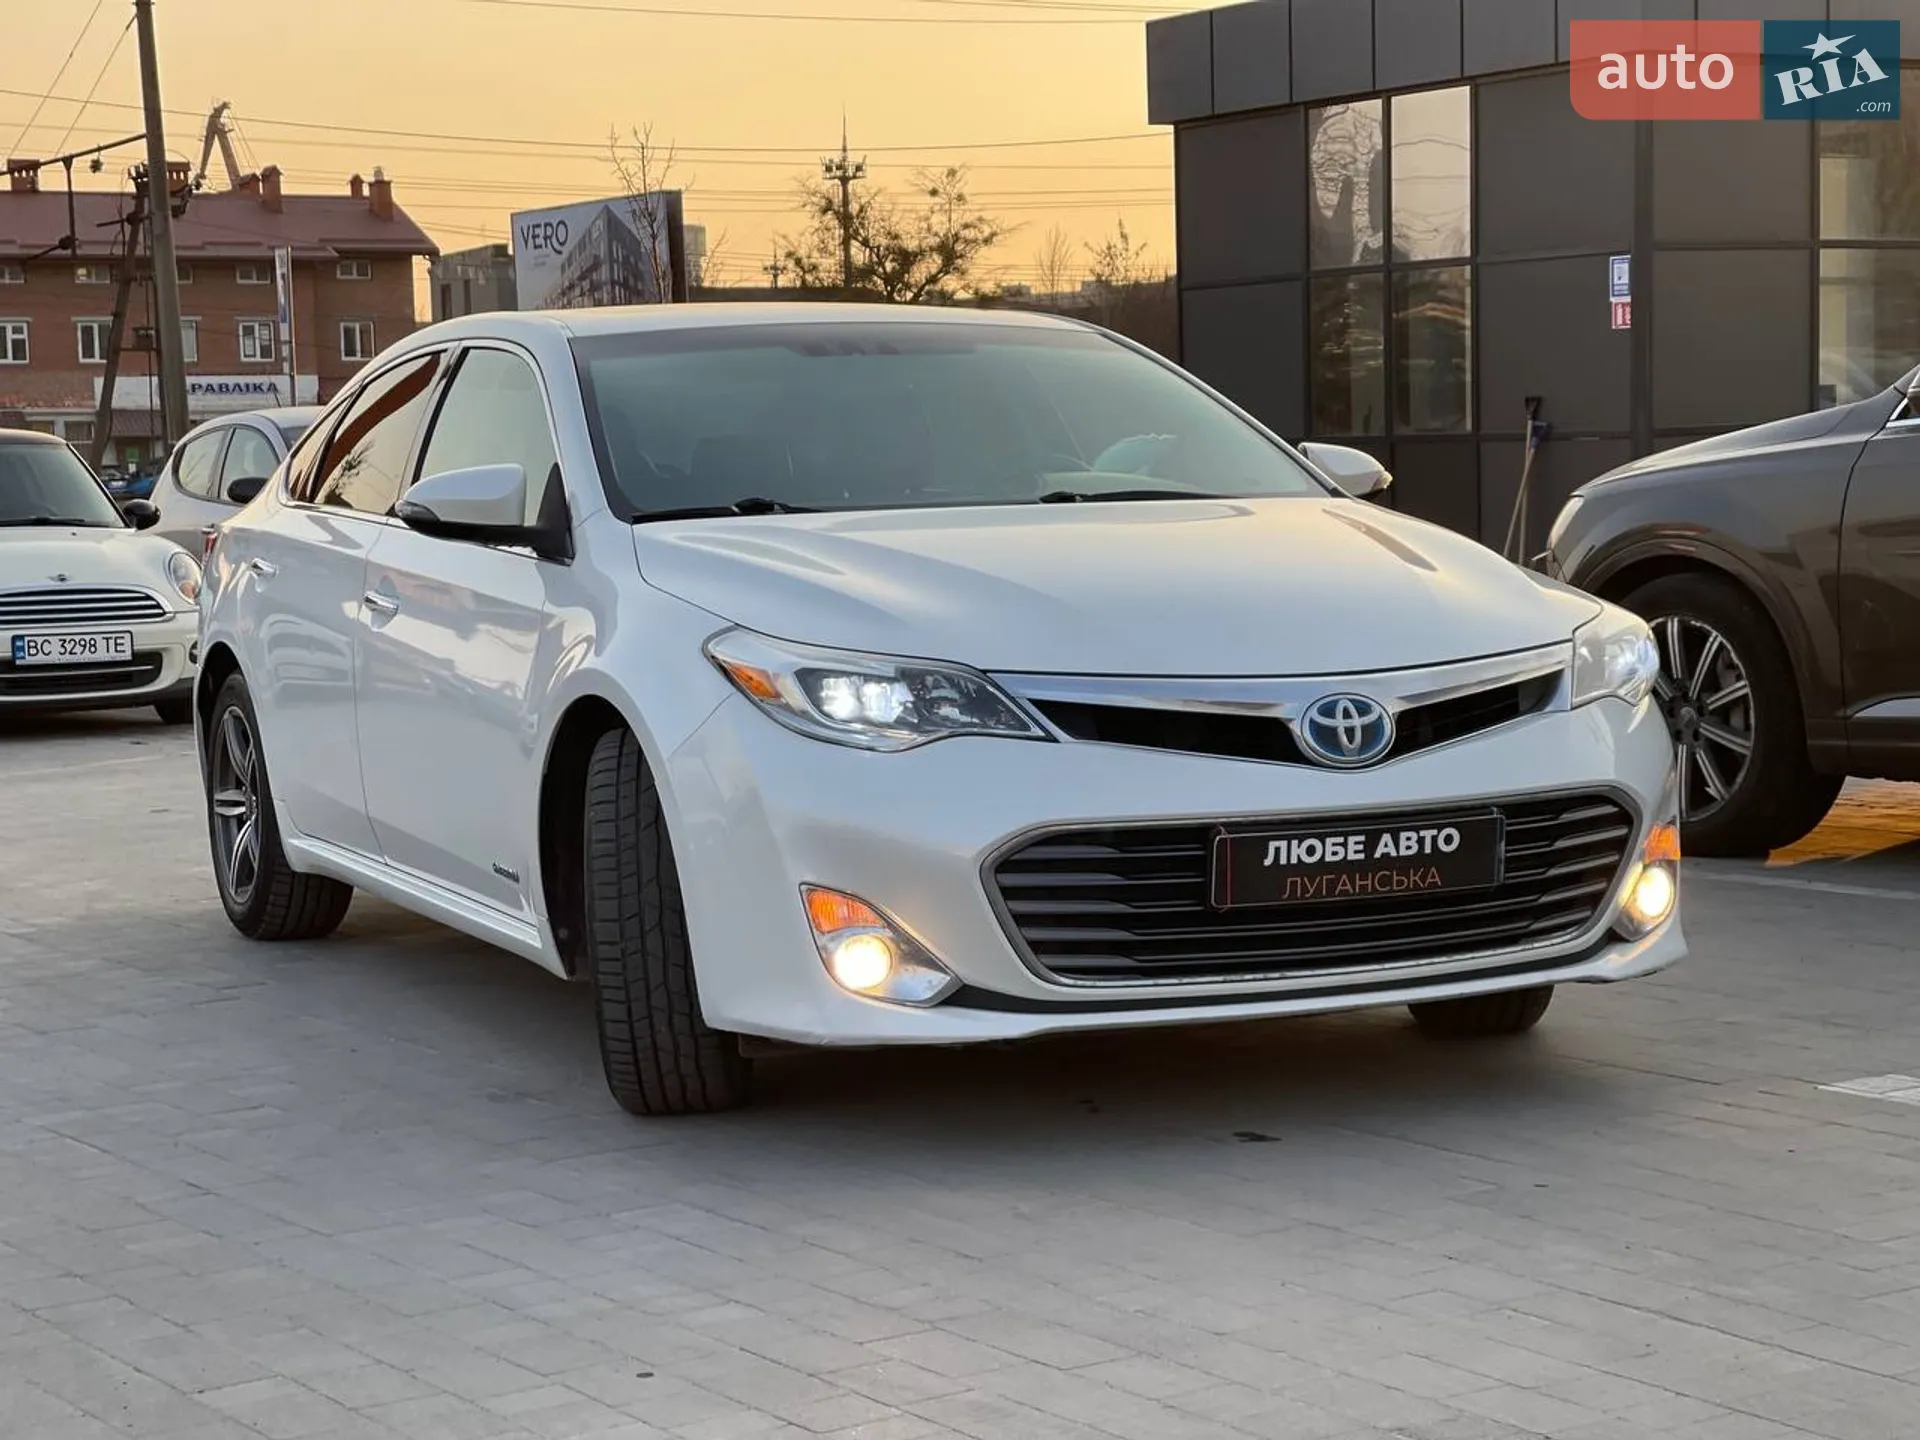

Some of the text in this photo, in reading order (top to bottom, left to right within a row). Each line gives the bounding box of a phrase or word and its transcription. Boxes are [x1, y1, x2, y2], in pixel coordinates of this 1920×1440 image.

[520, 220, 569, 255] VERO
[187, 382, 279, 394] РАВЛІКА
[27, 636, 126, 657] BC 3298 TE
[1263, 826, 1462, 867] ЛЮБЕ АВТО
[1282, 865, 1442, 899] ЛУГАНСЬКА
